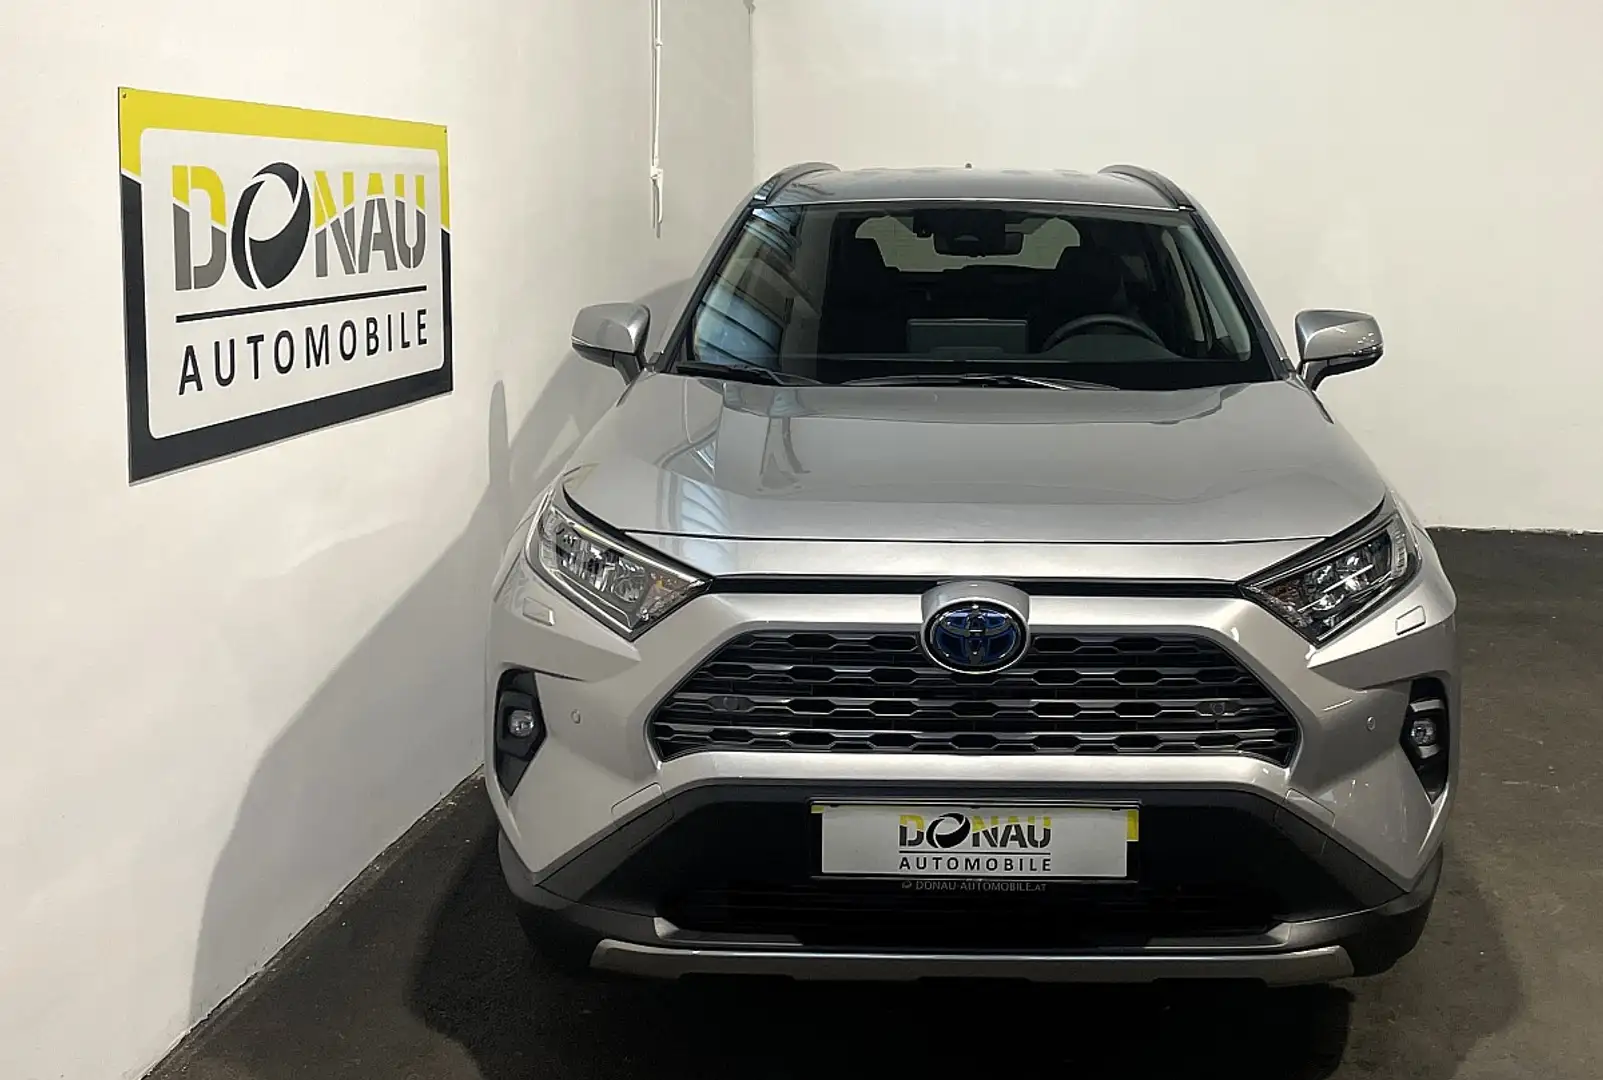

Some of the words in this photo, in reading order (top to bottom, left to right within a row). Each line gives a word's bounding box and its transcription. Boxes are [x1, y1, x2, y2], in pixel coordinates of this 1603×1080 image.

[172, 162, 427, 290] DONAU
[178, 309, 428, 395] AUTOMOBILE
[899, 812, 1051, 849] DONAU
[899, 857, 1051, 872] AUTOMOBILE
